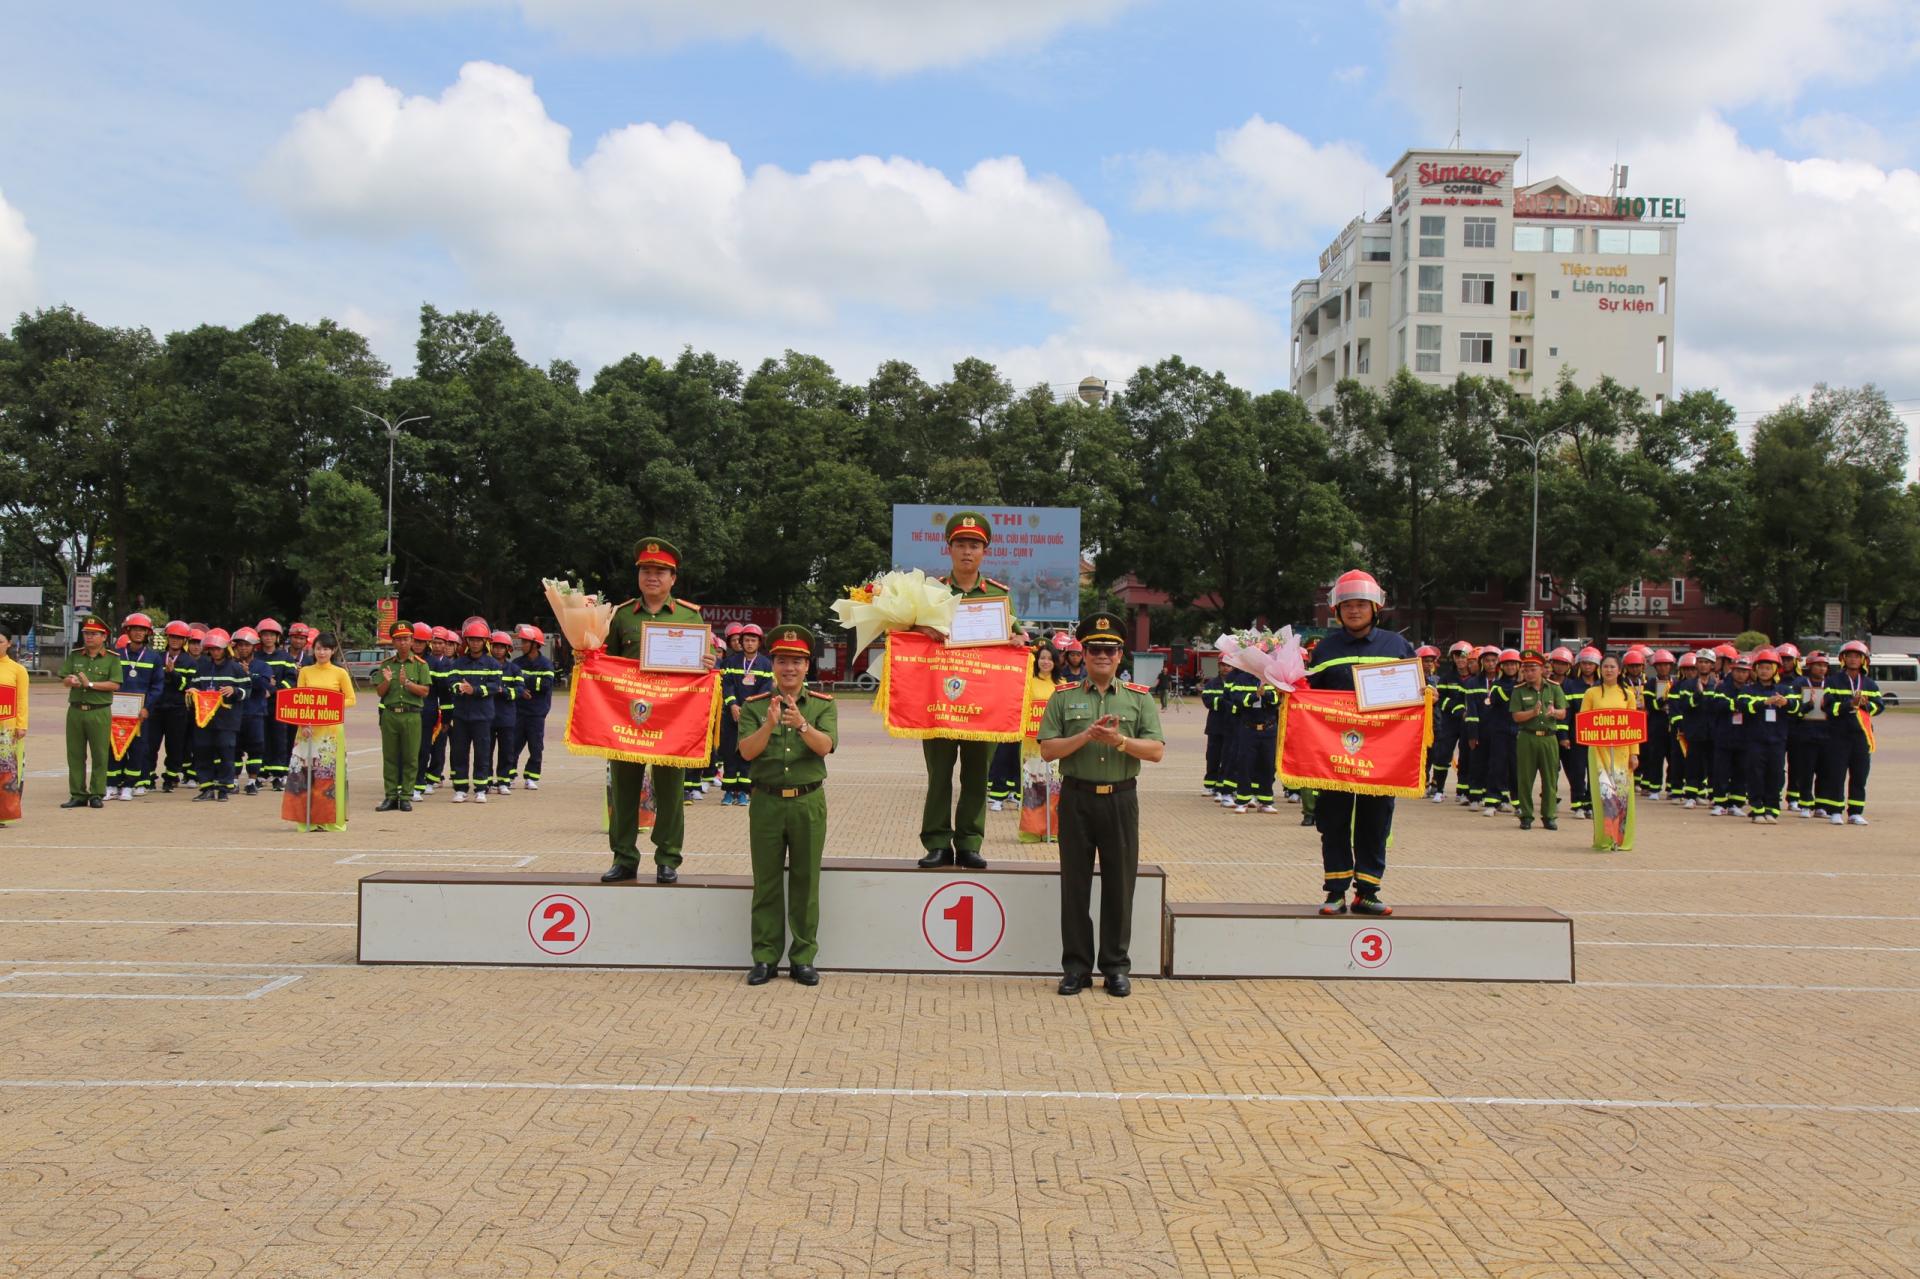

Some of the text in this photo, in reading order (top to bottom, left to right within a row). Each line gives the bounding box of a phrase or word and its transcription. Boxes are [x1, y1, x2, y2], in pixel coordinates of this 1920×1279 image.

[1444, 185, 1483, 194] COFFEE
[1617, 196, 1686, 218] HOTEL
[1573, 279, 1645, 294] Liên hoan
[1599, 298, 1654, 313] Sự kiện
[992, 513, 1022, 525] THI
[703, 608, 753, 621] MIXUE
[293, 692, 328, 705] CÔNG AN
[317, 708, 340, 720] NÔNG
[1593, 713, 1629, 726] CÔNG AN
[612, 724, 638, 737] GIẢI
[1330, 754, 1374, 768] GIẢI BA
[543, 903, 575, 941] 2
[944, 896, 973, 951] 1
[1361, 935, 1382, 961] 3
